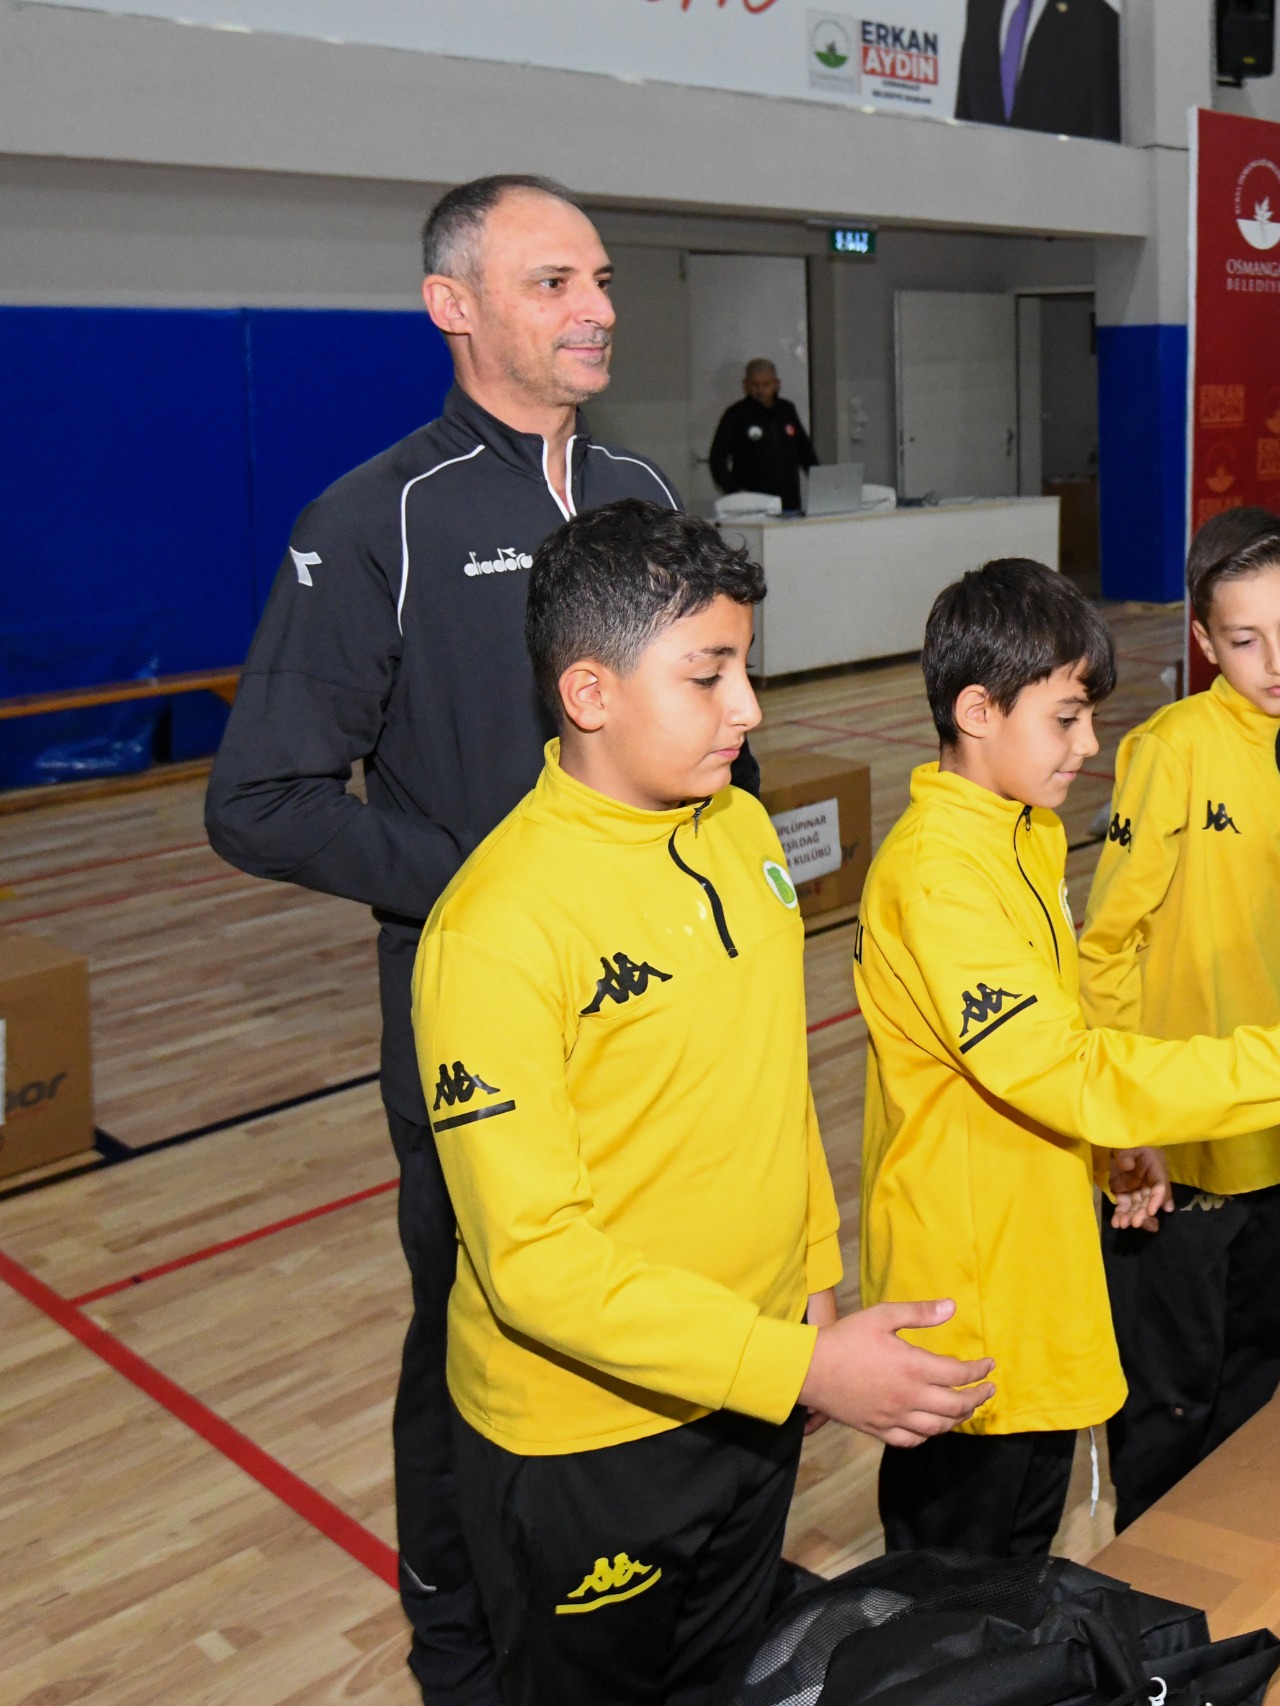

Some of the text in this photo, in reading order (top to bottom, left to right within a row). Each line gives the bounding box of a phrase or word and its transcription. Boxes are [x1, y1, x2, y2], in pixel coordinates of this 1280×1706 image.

[861, 20, 938, 56] ERKAN
[864, 46, 936, 82] AYDIN
[464, 547, 533, 577] diadora
